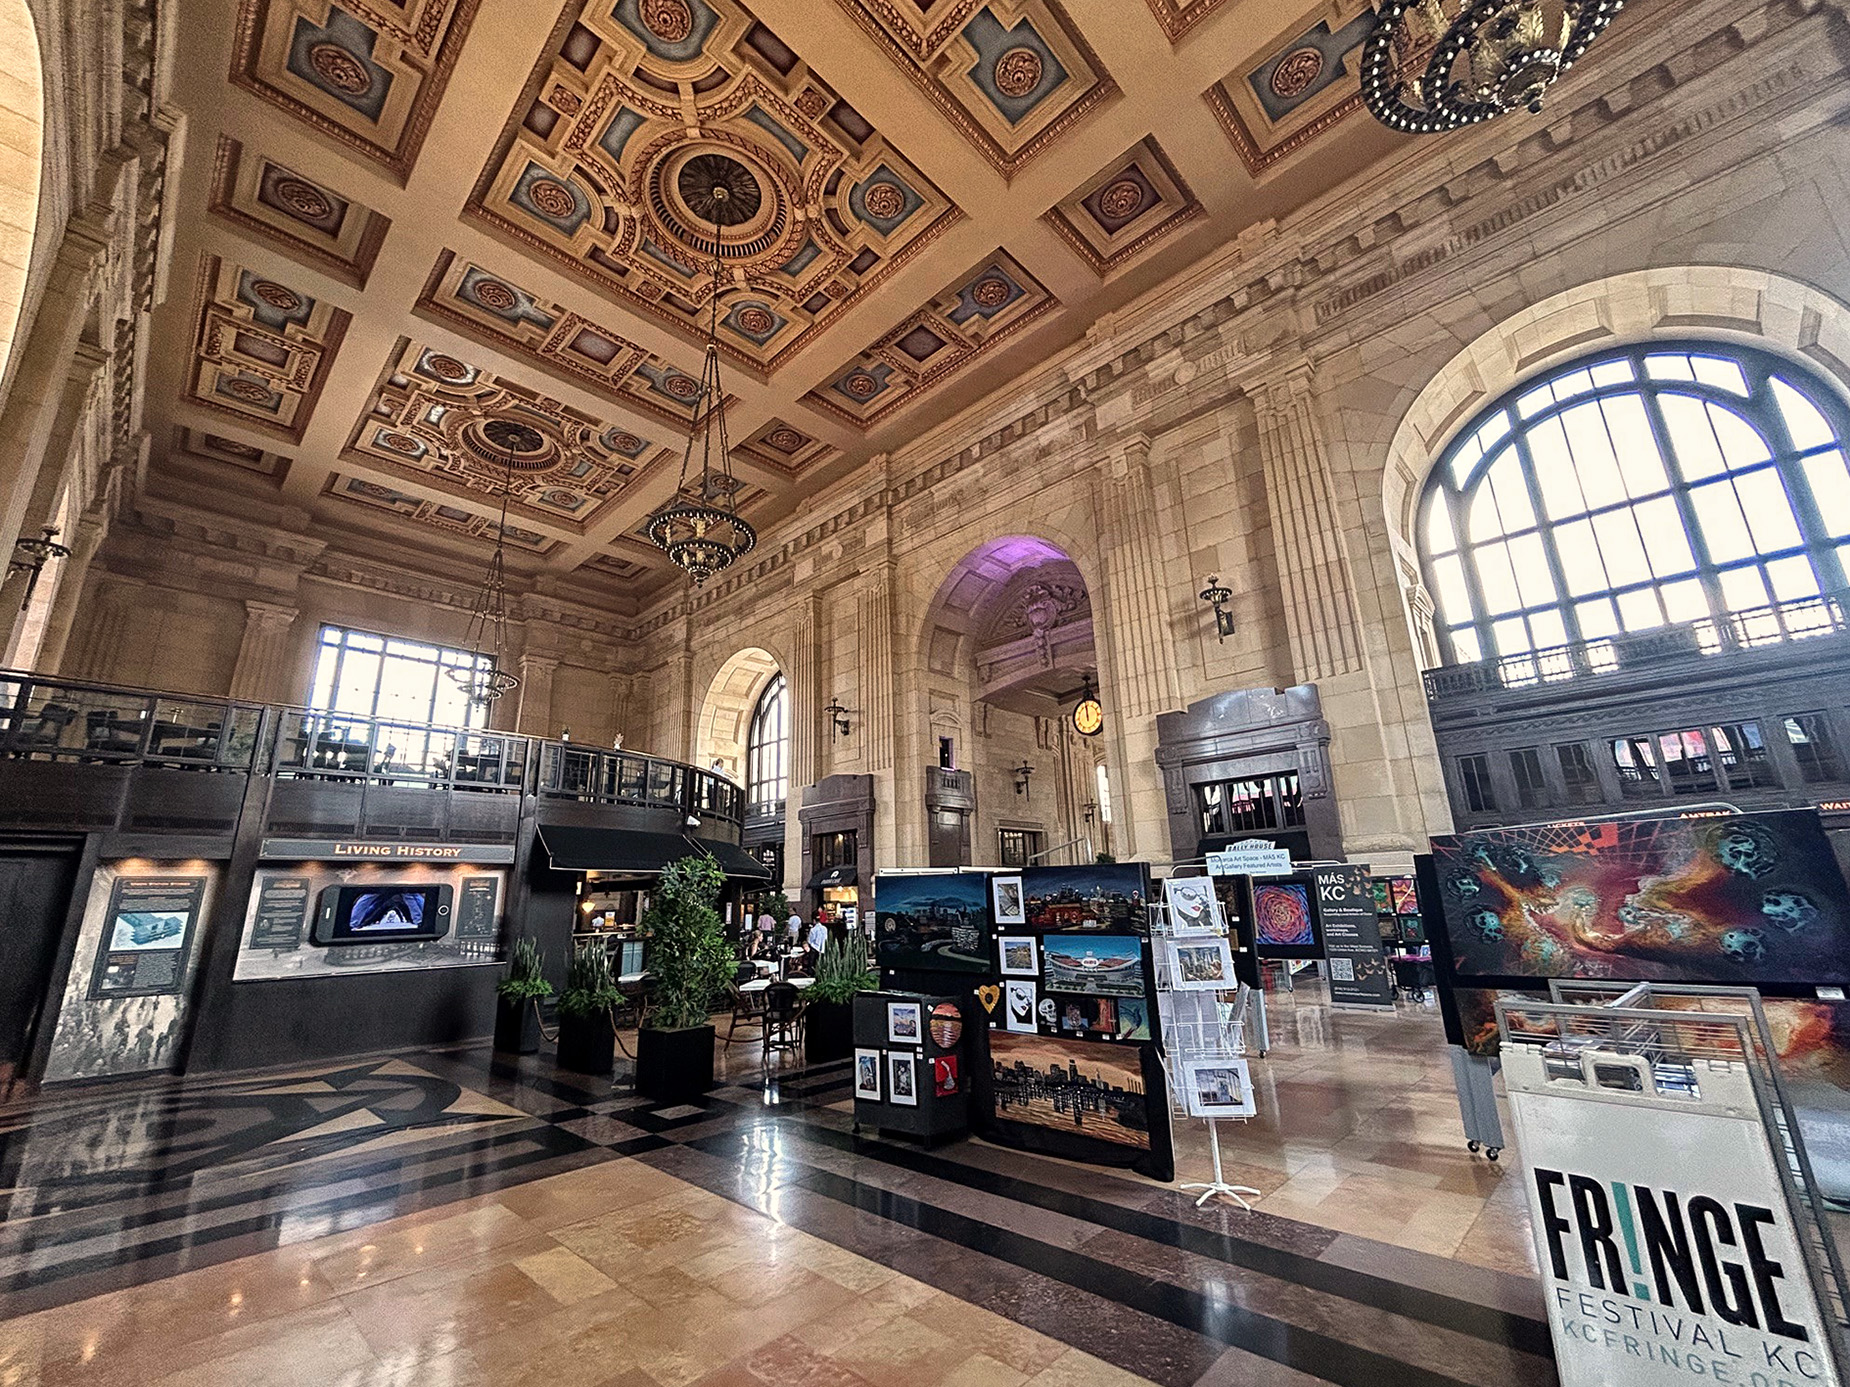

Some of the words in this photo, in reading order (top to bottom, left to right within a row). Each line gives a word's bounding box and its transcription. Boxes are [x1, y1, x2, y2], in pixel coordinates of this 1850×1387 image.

[334, 844, 391, 855] LIVING
[397, 846, 461, 857] HISTORY
[1228, 844, 1248, 852] RALLY
[1318, 872, 1345, 885] MÁS
[1320, 886, 1346, 901] KC
[1556, 1287, 1743, 1359] FESTIVAL
[1762, 1340, 1820, 1380] KC
